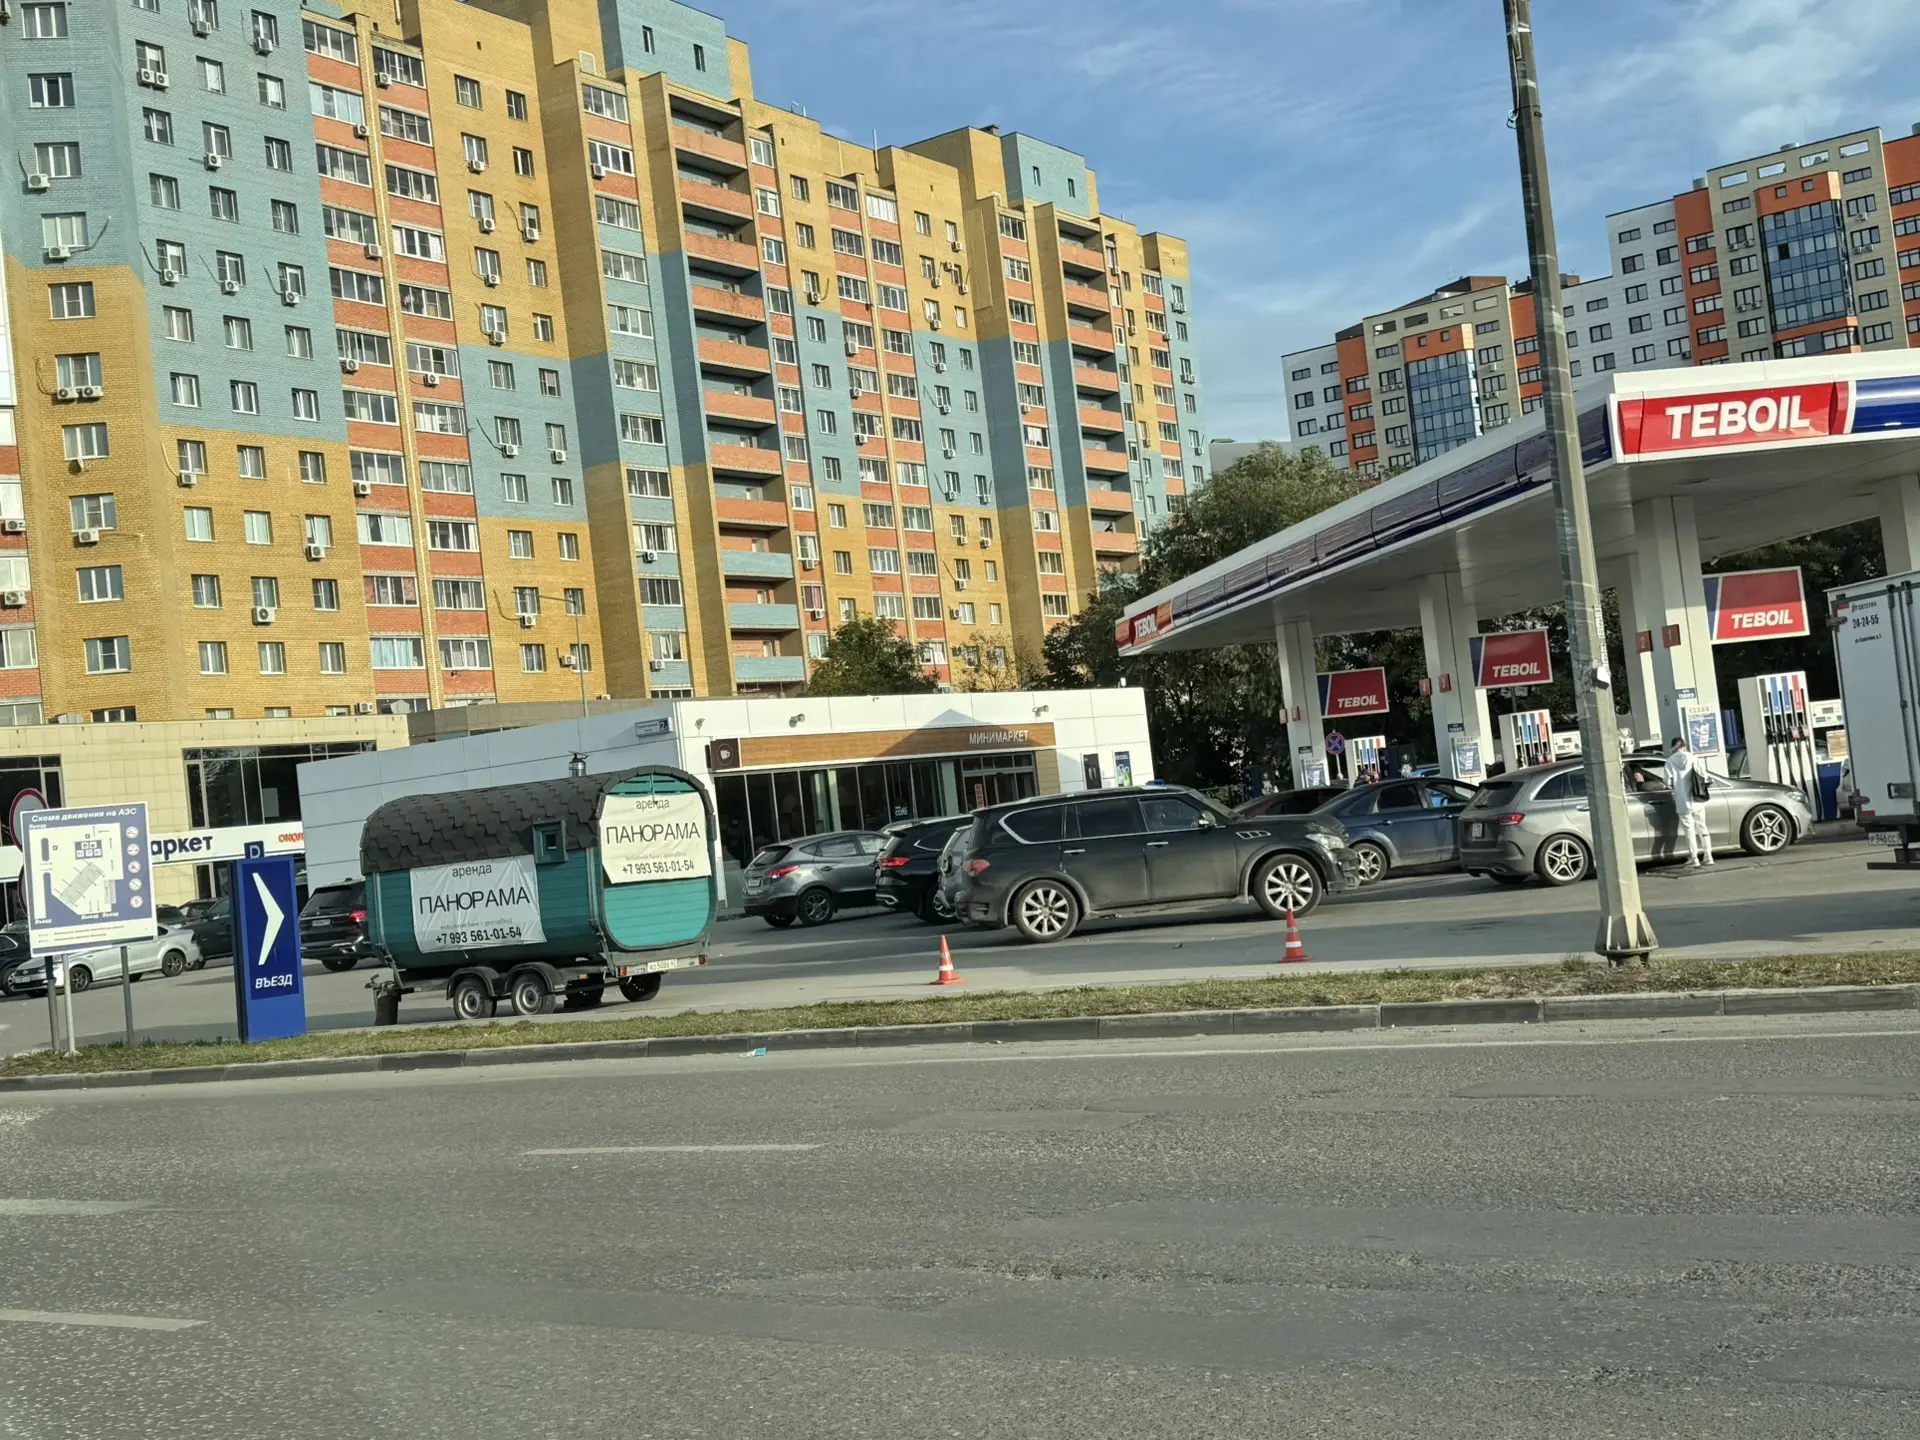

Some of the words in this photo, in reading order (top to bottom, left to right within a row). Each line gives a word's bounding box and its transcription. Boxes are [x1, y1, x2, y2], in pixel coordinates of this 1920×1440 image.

[1665, 395, 1810, 440] TEBOIL
[1134, 613, 1157, 639] TEBOIL
[1731, 609, 1794, 629] TEBOIL
[1492, 662, 1541, 678] TEBOIL
[1337, 695, 1379, 709] TEBOIL
[969, 730, 1029, 744] МИНИМАРКЕТ
[118, 808, 137, 816] АЗС
[636, 798, 670, 812] аренда
[606, 822, 700, 845] ПАНОРАМА
[452, 864, 492, 879] аренда
[622, 864, 633, 875] +7
[635, 862, 652, 874] 993
[653, 859, 694, 874] 561-01-54
[420, 886, 530, 915] ПАНОРАМА
[436, 933, 447, 944] +7
[450, 931, 468, 944] 993
[470, 926, 522, 942] 561-01-54
[255, 974, 293, 989] ВЪЕЗД
